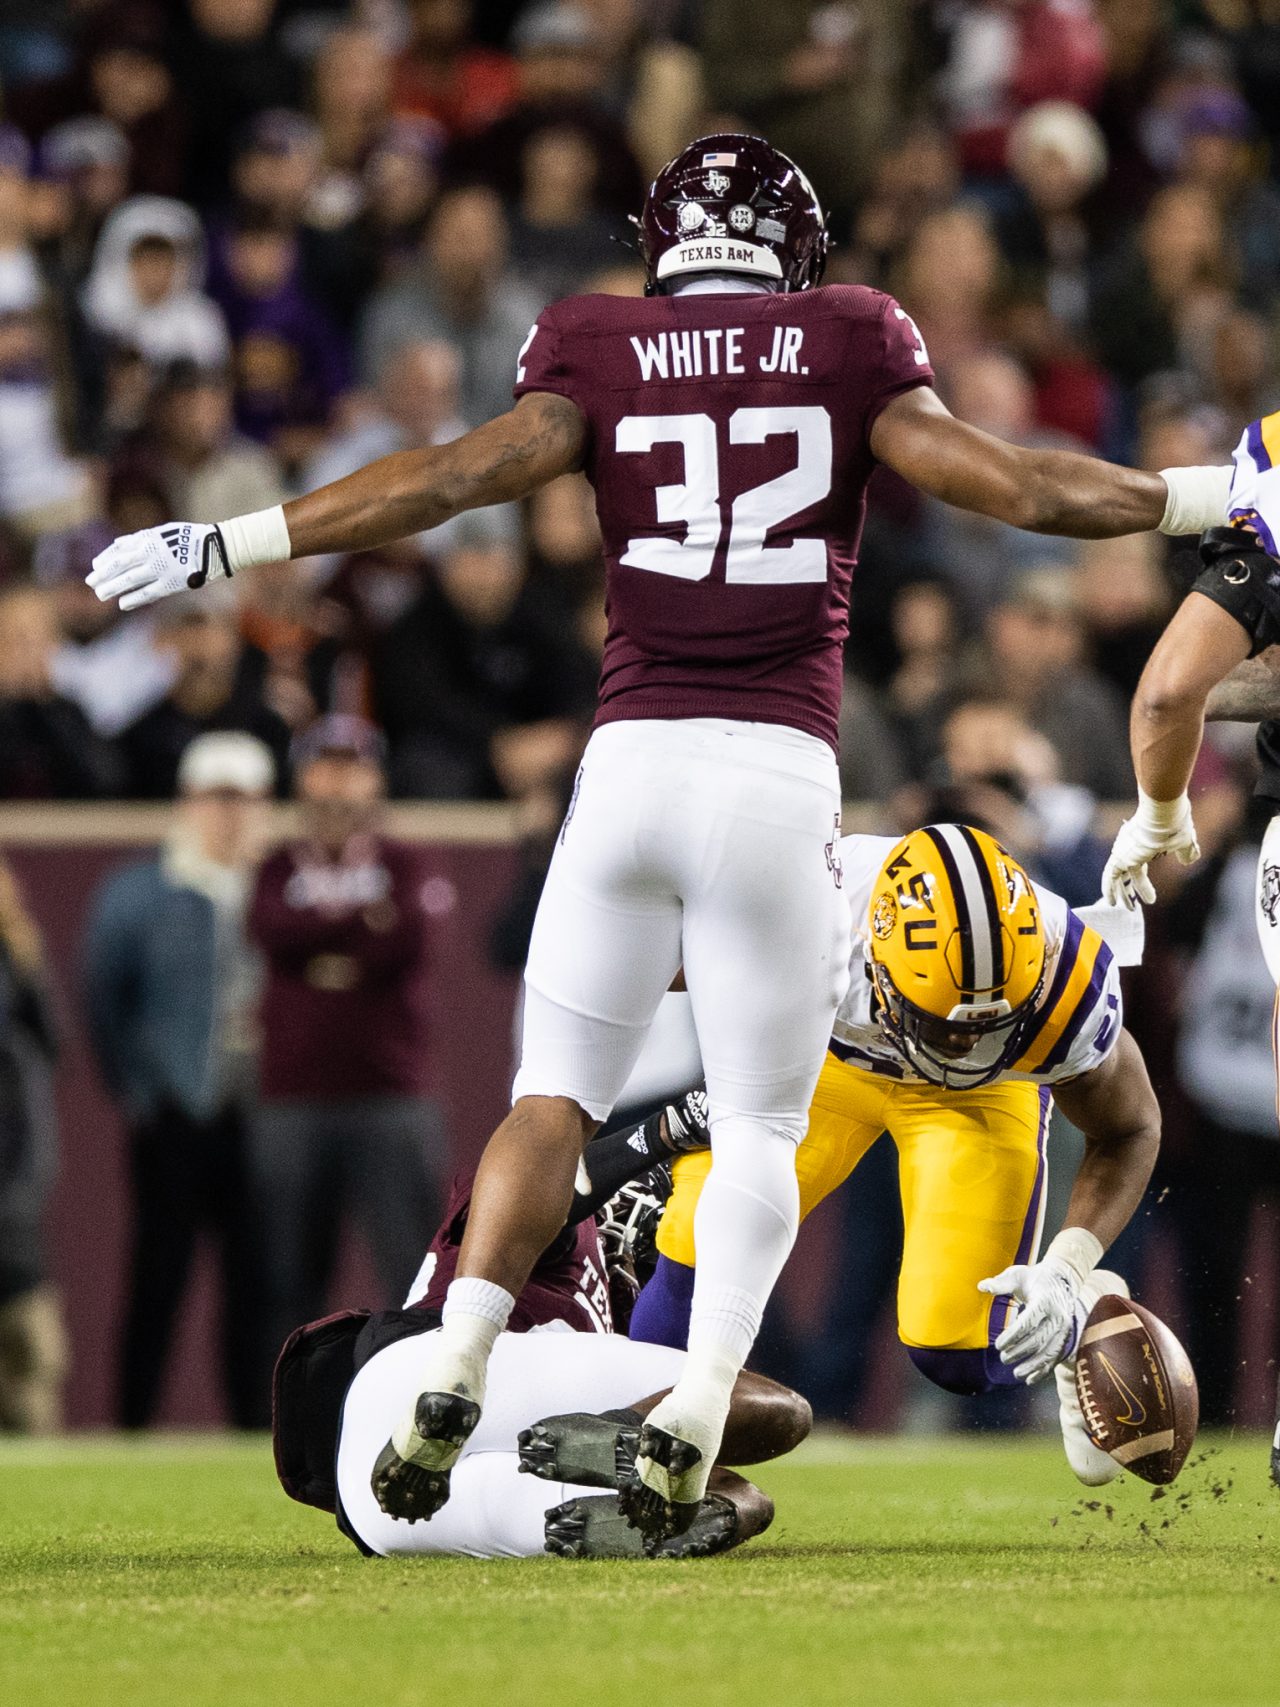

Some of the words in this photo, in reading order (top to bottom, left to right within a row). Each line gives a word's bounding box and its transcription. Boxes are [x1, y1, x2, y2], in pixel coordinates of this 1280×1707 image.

[679, 246, 722, 264] TEXAS
[727, 247, 754, 264] A&M
[516, 324, 539, 384] 2
[629, 327, 745, 382] WHITE
[759, 326, 810, 376] JR.
[894, 308, 931, 366] 3
[615, 406, 832, 584] 32
[179, 525, 192, 565] adidas
[685, 1091, 707, 1129] adidas
[637, 1124, 649, 1155] adidas
